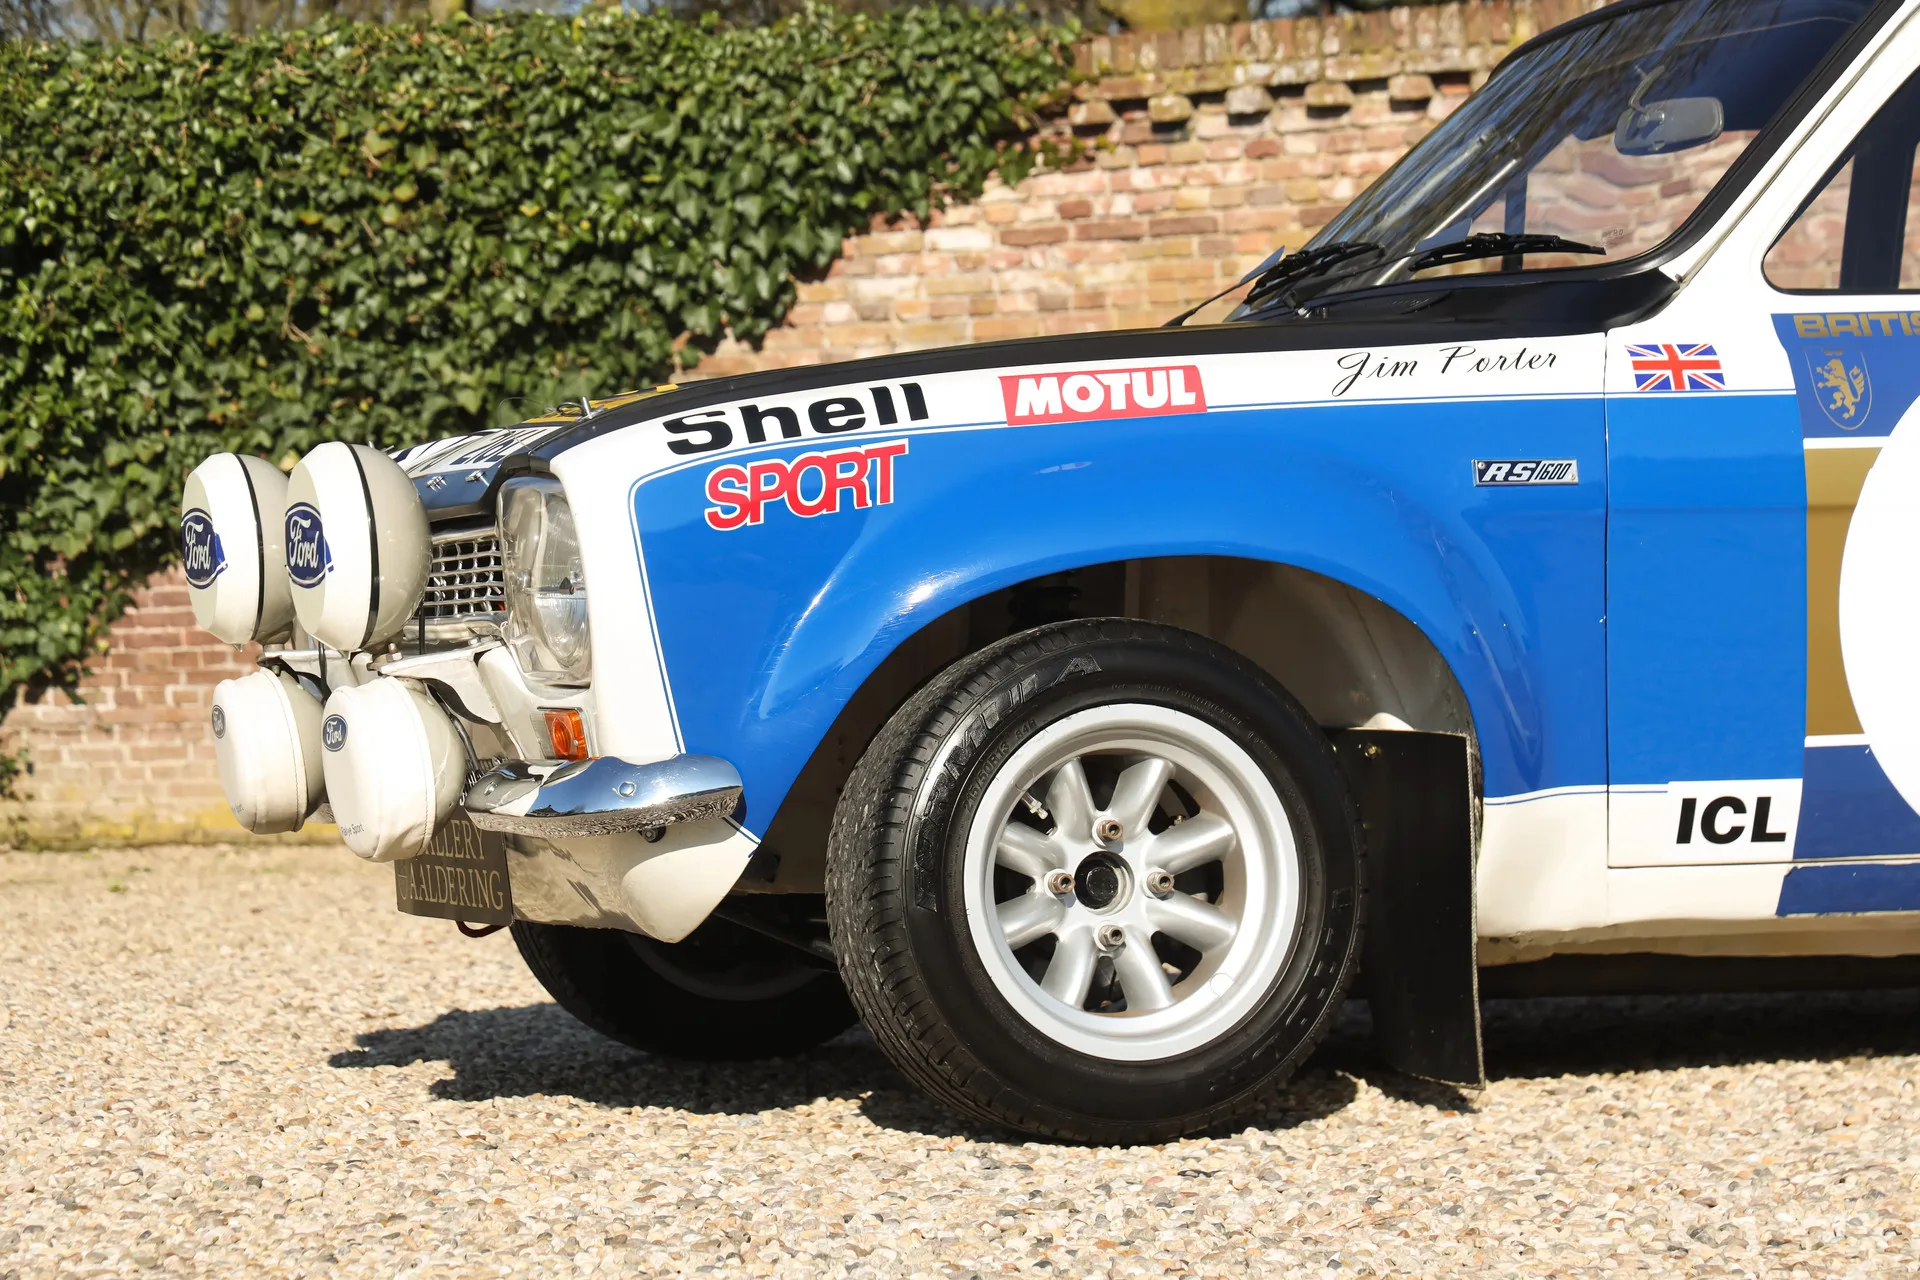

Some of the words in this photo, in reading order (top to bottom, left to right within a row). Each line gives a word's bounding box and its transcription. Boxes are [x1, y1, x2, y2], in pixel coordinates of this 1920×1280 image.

[1014, 367, 1198, 417] MOTUL
[1332, 351, 1418, 397] Jim
[1439, 346, 1557, 376] Porter
[662, 382, 930, 456] Shell
[703, 437, 910, 531] SPORT
[185, 520, 212, 571] Ford
[289, 515, 320, 569] Ford
[326, 720, 343, 745] Ford
[1675, 795, 1787, 845] ICL
